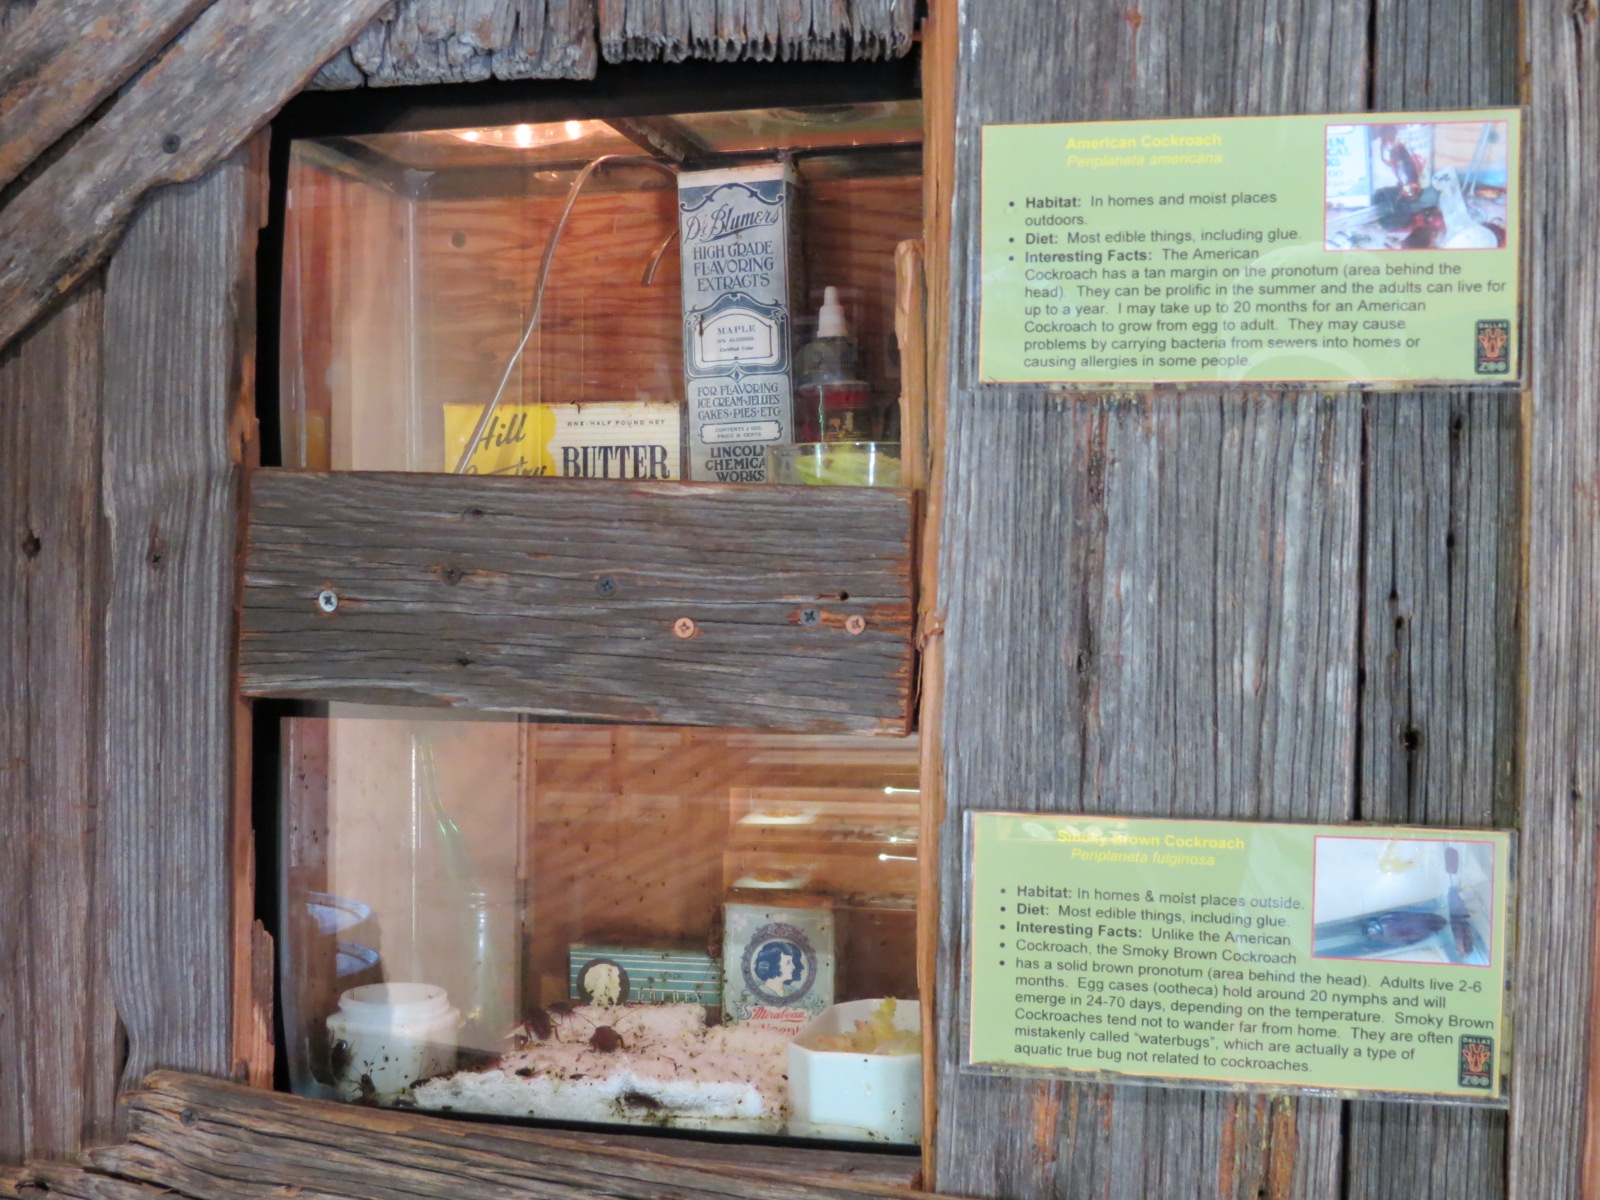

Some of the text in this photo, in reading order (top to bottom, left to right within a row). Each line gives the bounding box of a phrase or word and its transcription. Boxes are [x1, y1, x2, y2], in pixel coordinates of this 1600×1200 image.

[1066, 134, 1222, 150] American Cockroach
[1025, 190, 1277, 209] Habitat: In homes and moist places
[1024, 213, 1087, 226] outdoors.
[1024, 227, 1302, 245] Diet: Most edible things, including glue.
[693, 241, 774, 260] HIGH GRADE
[1024, 246, 1259, 265] Interesting Facts: The American
[694, 257, 775, 276] FLAVORING
[1024, 261, 1461, 281] Cockroach has a tan margin on the pronotum (area behind the
[697, 272, 771, 292] EXTRACTS
[1024, 298, 1426, 318] up to a year. I may take up to 20 months for an American
[717, 324, 756, 336] MAPLE
[1023, 335, 1420, 352] problems by carrying bacteria from sewers into homes or
[1023, 354, 1252, 370] causing allergies in some people.
[1478, 361, 1507, 372] ZOO
[697, 382, 779, 398] FOR FLAVORING
[697, 397, 712, 408] ICE
[615, 419, 645, 427] POUND
[648, 418, 666, 426] NET
[561, 444, 671, 480] BUTTER
[705, 457, 766, 472] CHEMICA
[716, 469, 766, 483] WORKS
[1165, 836, 1245, 850] Cockroach
[1016, 883, 1304, 909] Habitat: In homes & moist places outside.
[1016, 902, 1289, 930] Diet: Most edible things, including glue.
[1015, 920, 1291, 946] Interesting Facts: Unlike the American
[1015, 938, 1296, 964] Cockroach, the Smoky Brown Cockroach
[1015, 956, 1482, 993] has a solid brown pronotum (area behind the head). Adults live 2-6
[751, 1006, 805, 1020] Mirabeau
[1014, 1007, 1453, 1044] Cockroaches tend not to wander far from home. They are often
[1013, 1041, 1312, 1072] aquatic true bug not related to cockroaches.
[1461, 1075, 1490, 1087] ZOO
